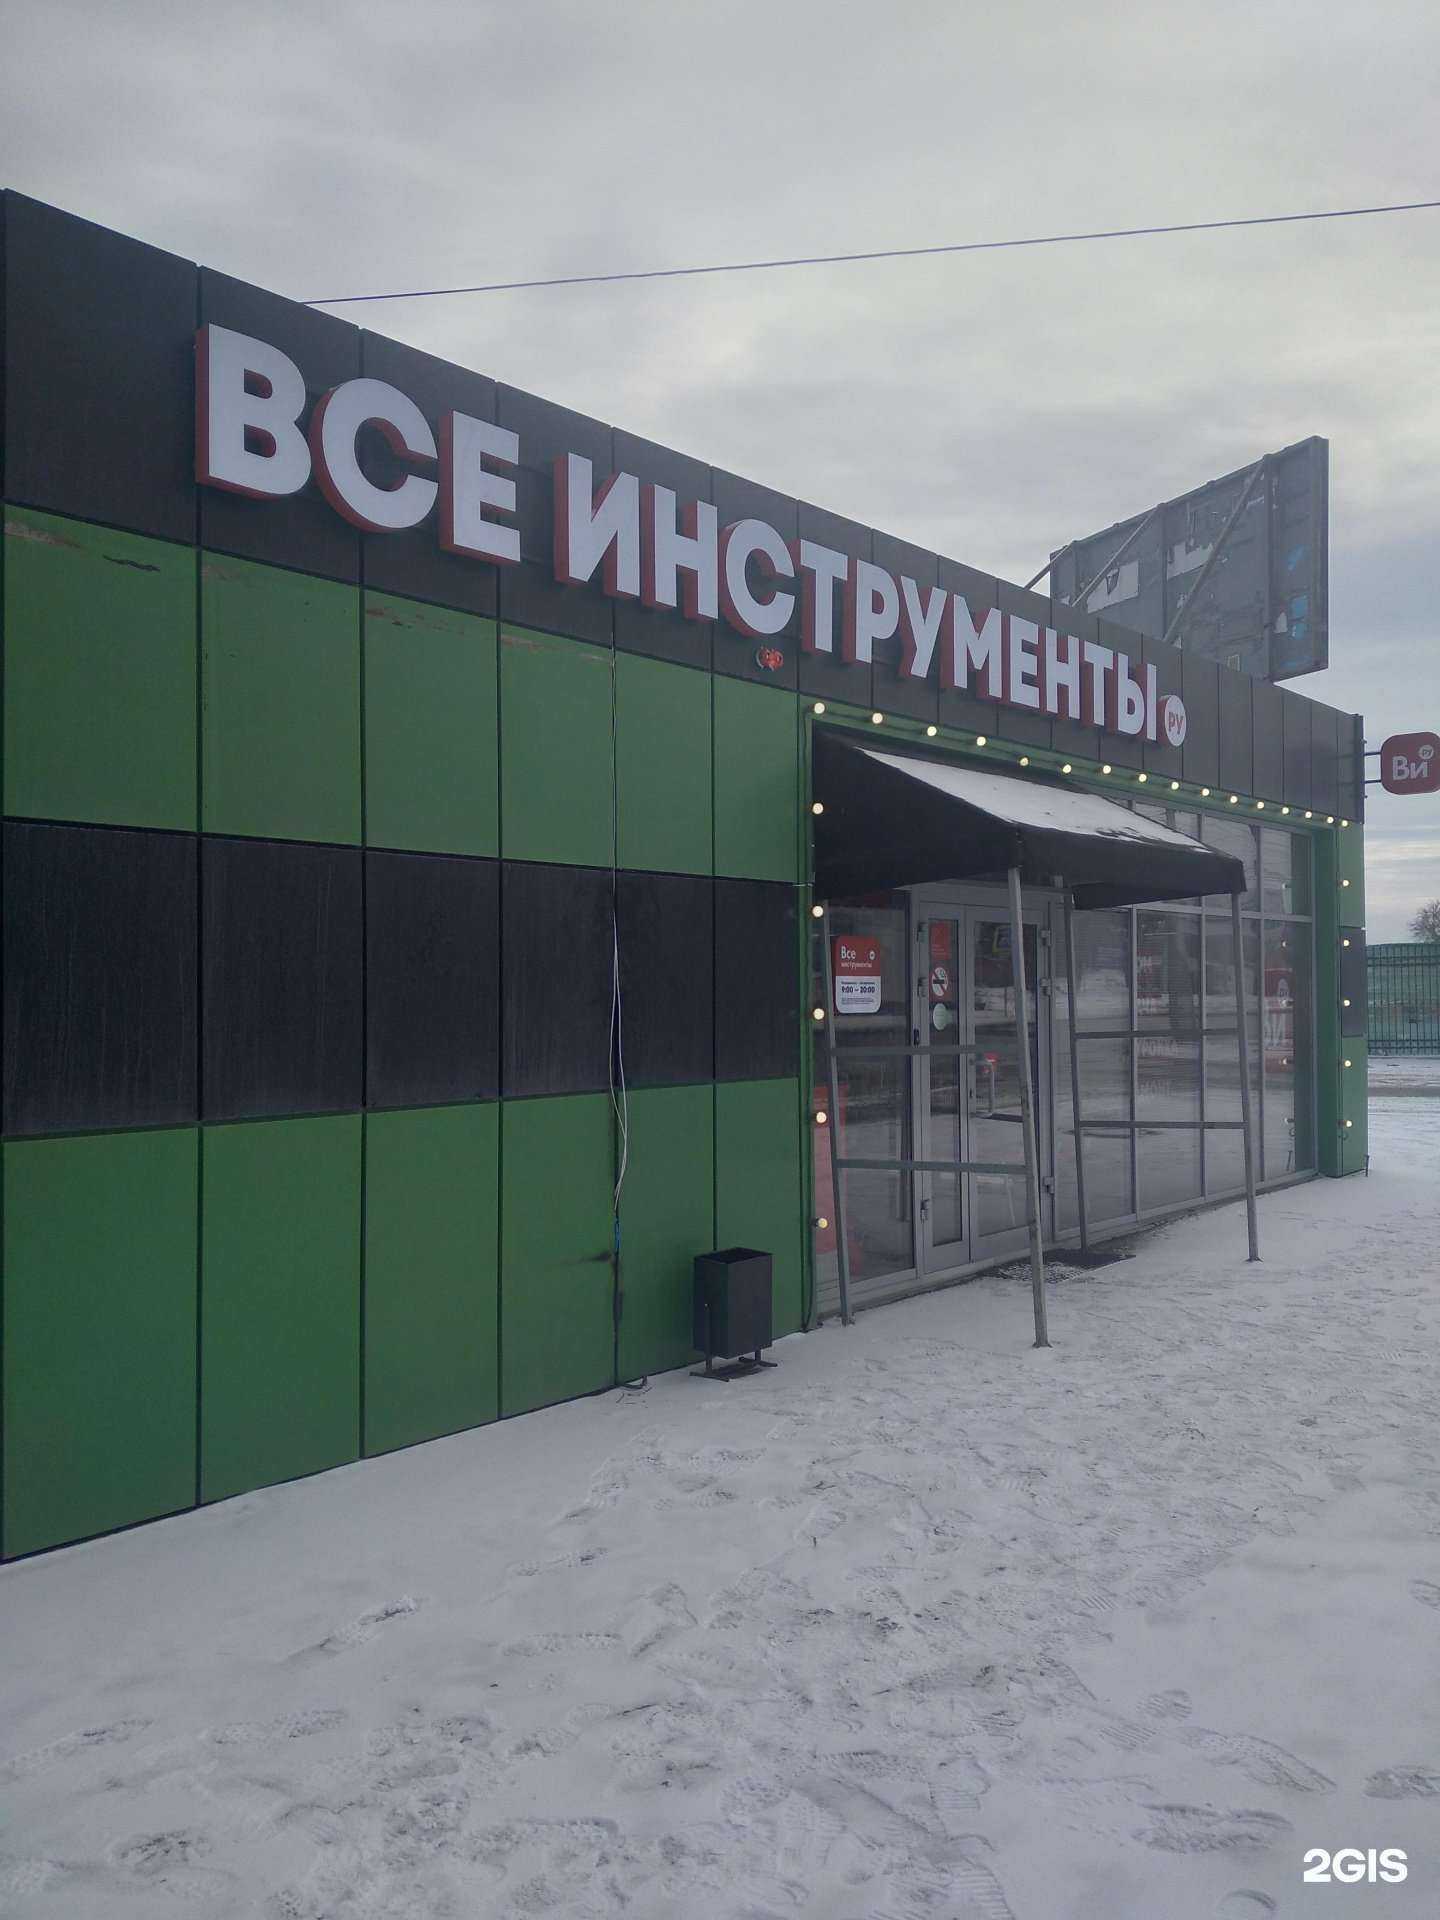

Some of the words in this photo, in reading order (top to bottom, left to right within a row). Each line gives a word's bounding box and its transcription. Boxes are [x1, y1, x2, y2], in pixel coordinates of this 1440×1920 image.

[203, 323, 521, 562] ВСЕ
[563, 451, 1157, 741] ИНСТРУМЕНТЫ
[841, 945, 857, 960] Все
